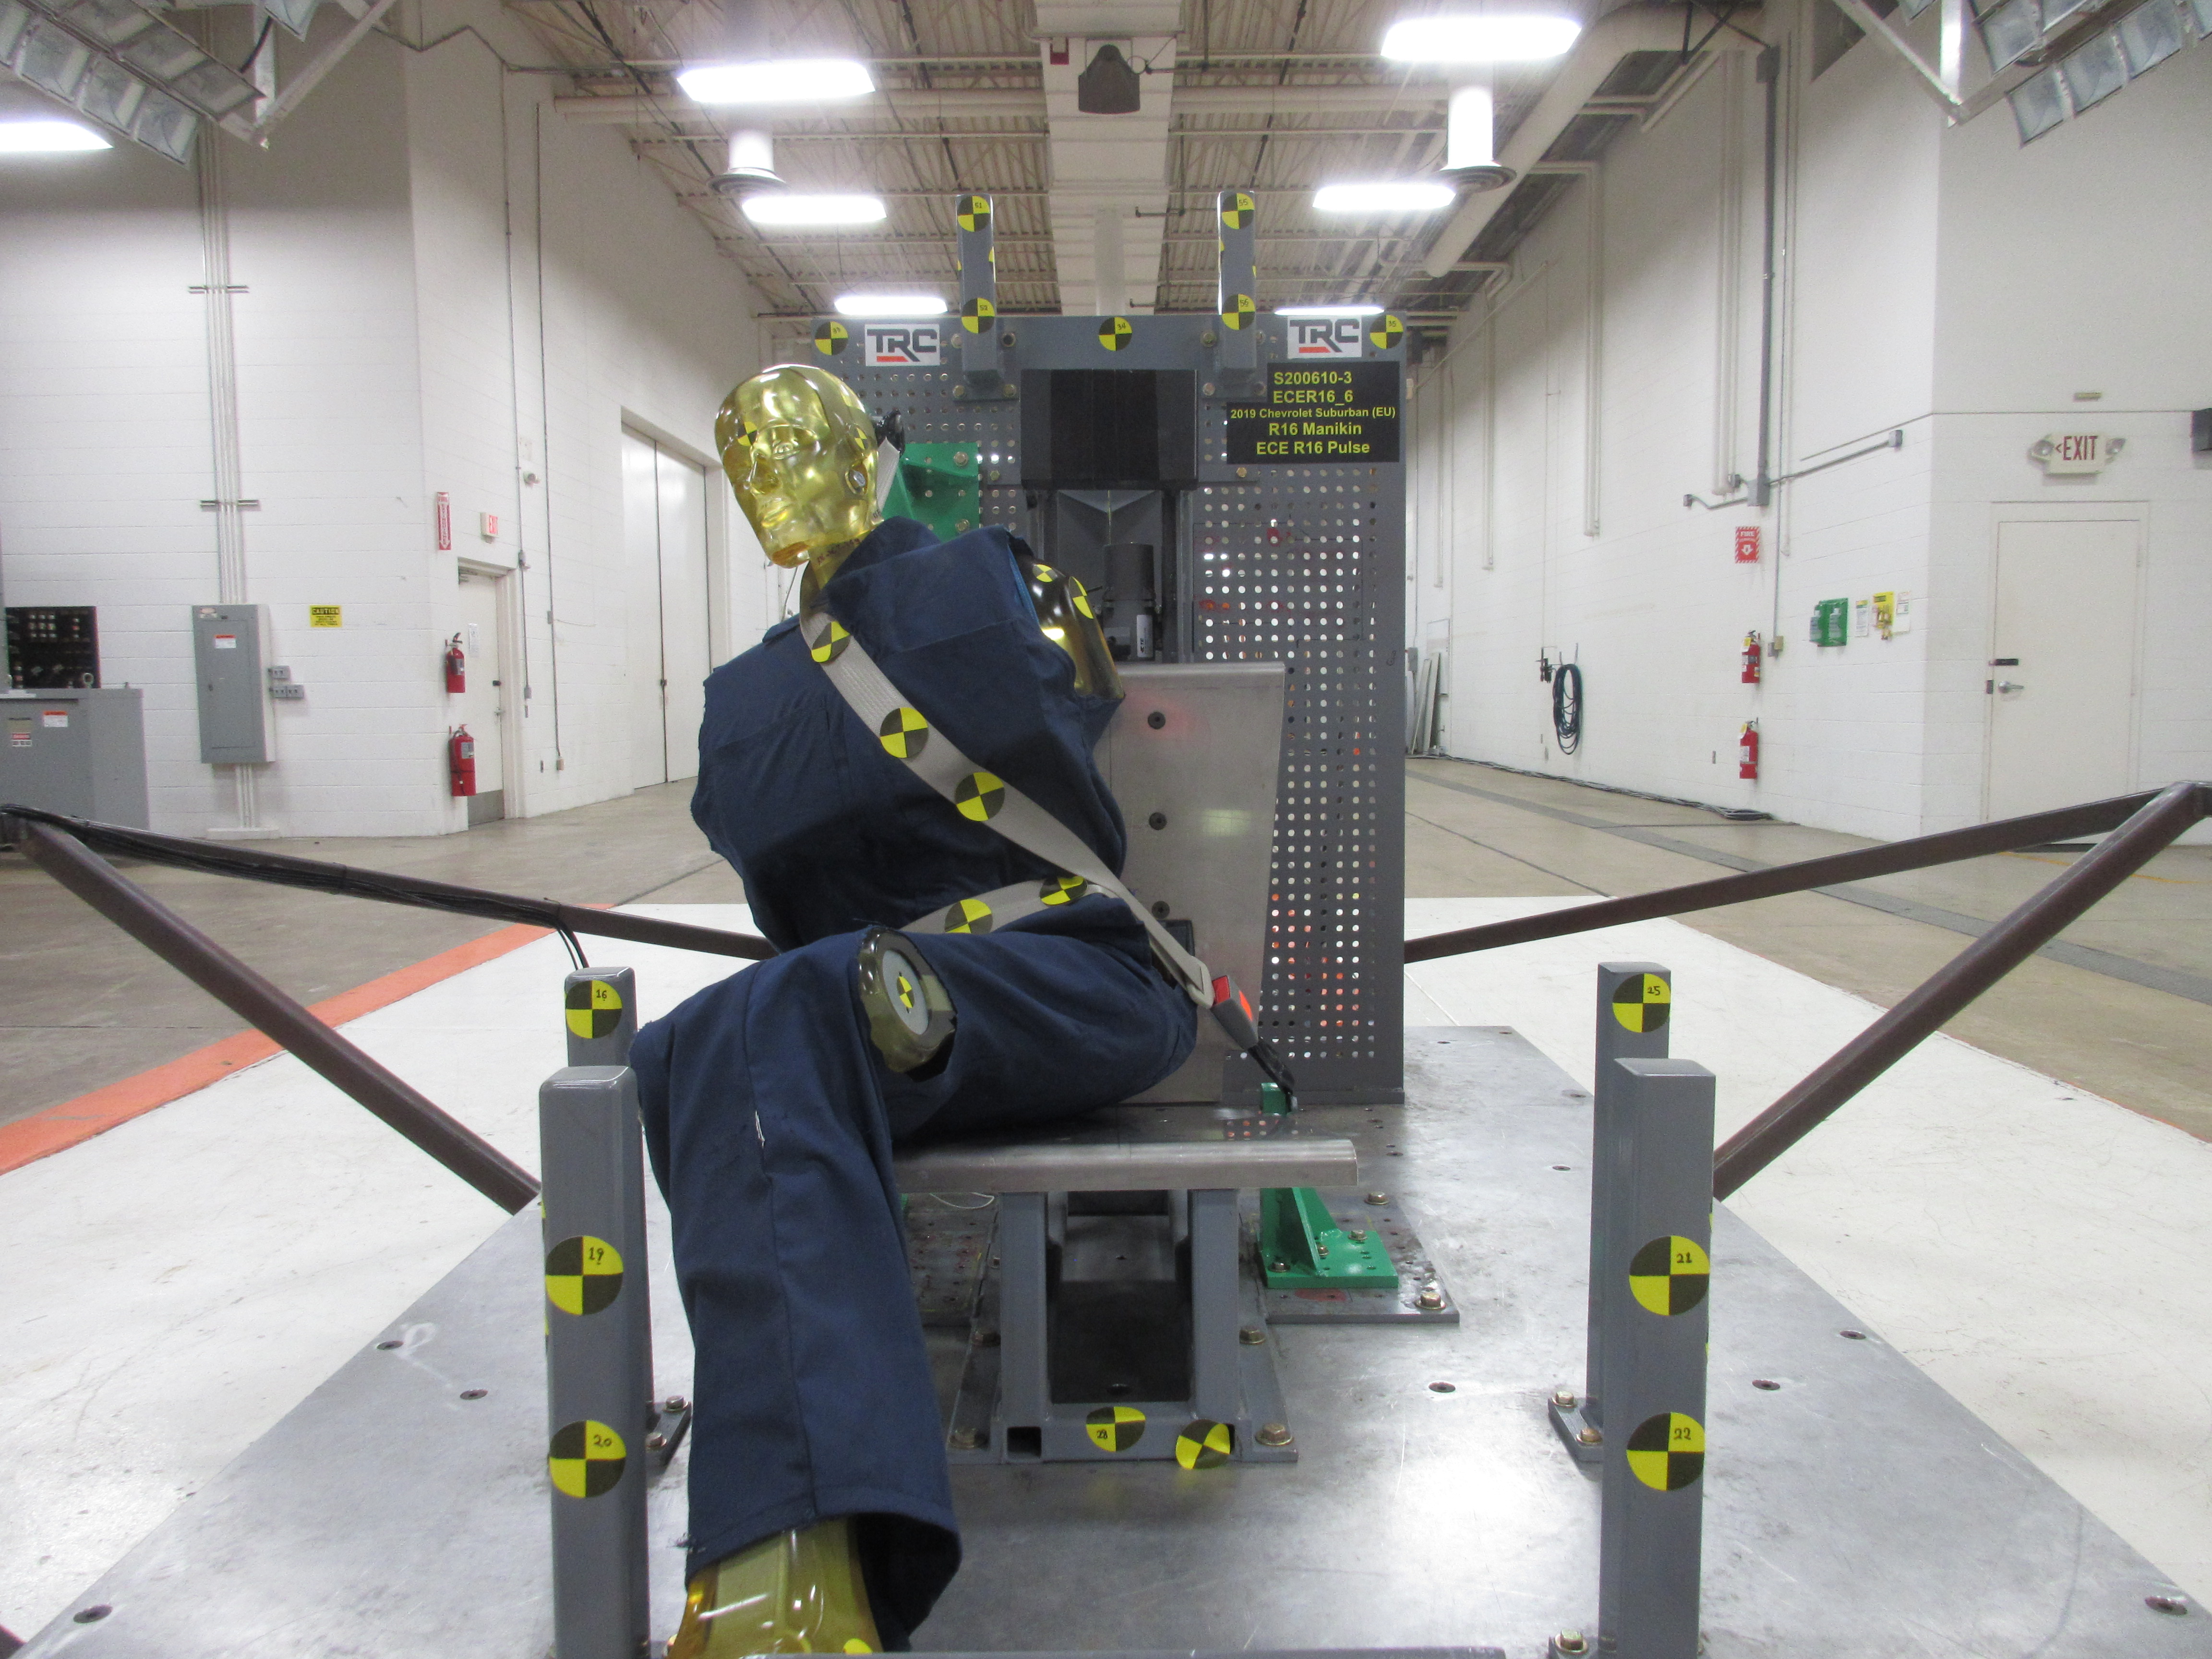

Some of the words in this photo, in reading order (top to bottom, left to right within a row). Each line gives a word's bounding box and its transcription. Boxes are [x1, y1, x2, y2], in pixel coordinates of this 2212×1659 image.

[1118, 322, 1126, 330] 34
[1289, 318, 1360, 356] TRC
[867, 328, 938, 361] TRC
[1274, 371, 1353, 385] S200610-3
[1273, 390, 1354, 406] ECER16_6
[1230, 409, 1256, 419] 2019
[1259, 409, 1312, 418] Chevrolet
[1315, 408, 1369, 418] Suburban
[1372, 407, 1396, 419] (EU)
[1269, 422, 1298, 435] R16
[1303, 422, 1362, 435] Manikin
[1256, 442, 1289, 455] ECE
[1294, 441, 1323, 454] R16
[1327, 441, 1370, 454] Pulse
[2063, 435, 2098, 460] EXIT
[596, 989, 607, 999] 16
[590, 1247, 604, 1262] 19
[1676, 1251, 1692, 1263] 21
[1673, 1427, 1691, 1440] 22
[594, 1434, 612, 1447] 20
